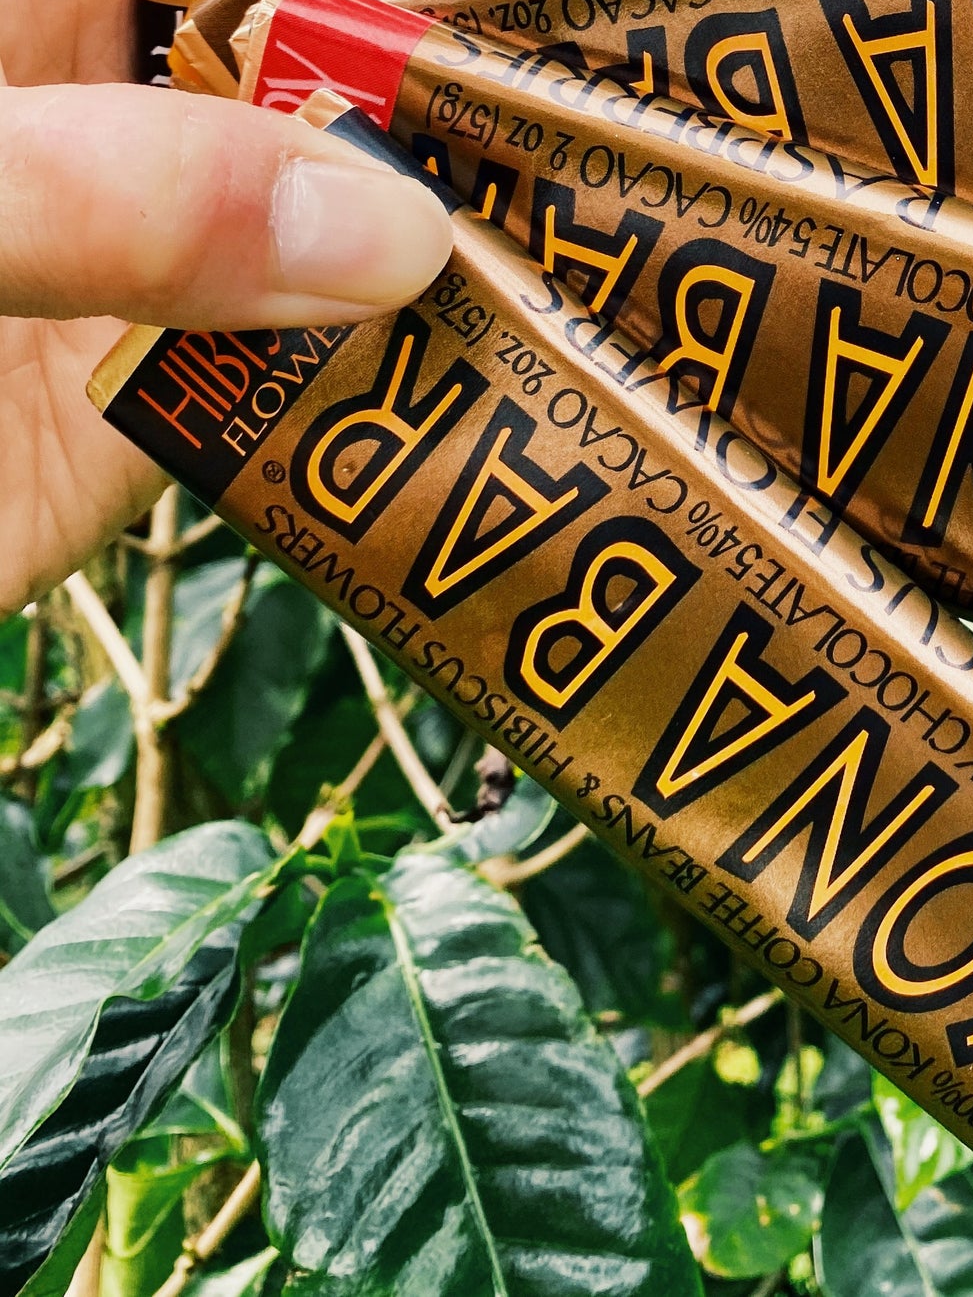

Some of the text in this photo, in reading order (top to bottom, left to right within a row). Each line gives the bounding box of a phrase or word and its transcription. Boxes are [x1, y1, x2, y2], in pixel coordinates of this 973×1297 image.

[425, 82, 499, 149] (57g)
[580, 145, 731, 228] CACAO
[738, 197, 818, 258] 54%
[221, 326, 347, 457] FLOWE
[547, 388, 688, 514] CACAO
[290, 307, 703, 732] BAR
[686, 500, 763, 580] 54%
[255, 505, 420, 650] FLOWERS
[745, 559, 971, 754] CHOCOLATE
[413, 640, 574, 782] HIBISCUS
[576, 772, 600, 799] &
[591, 794, 706, 895] BEANS
[704, 882, 823, 988] COFFEE
[823, 980, 935, 1080] KONA
